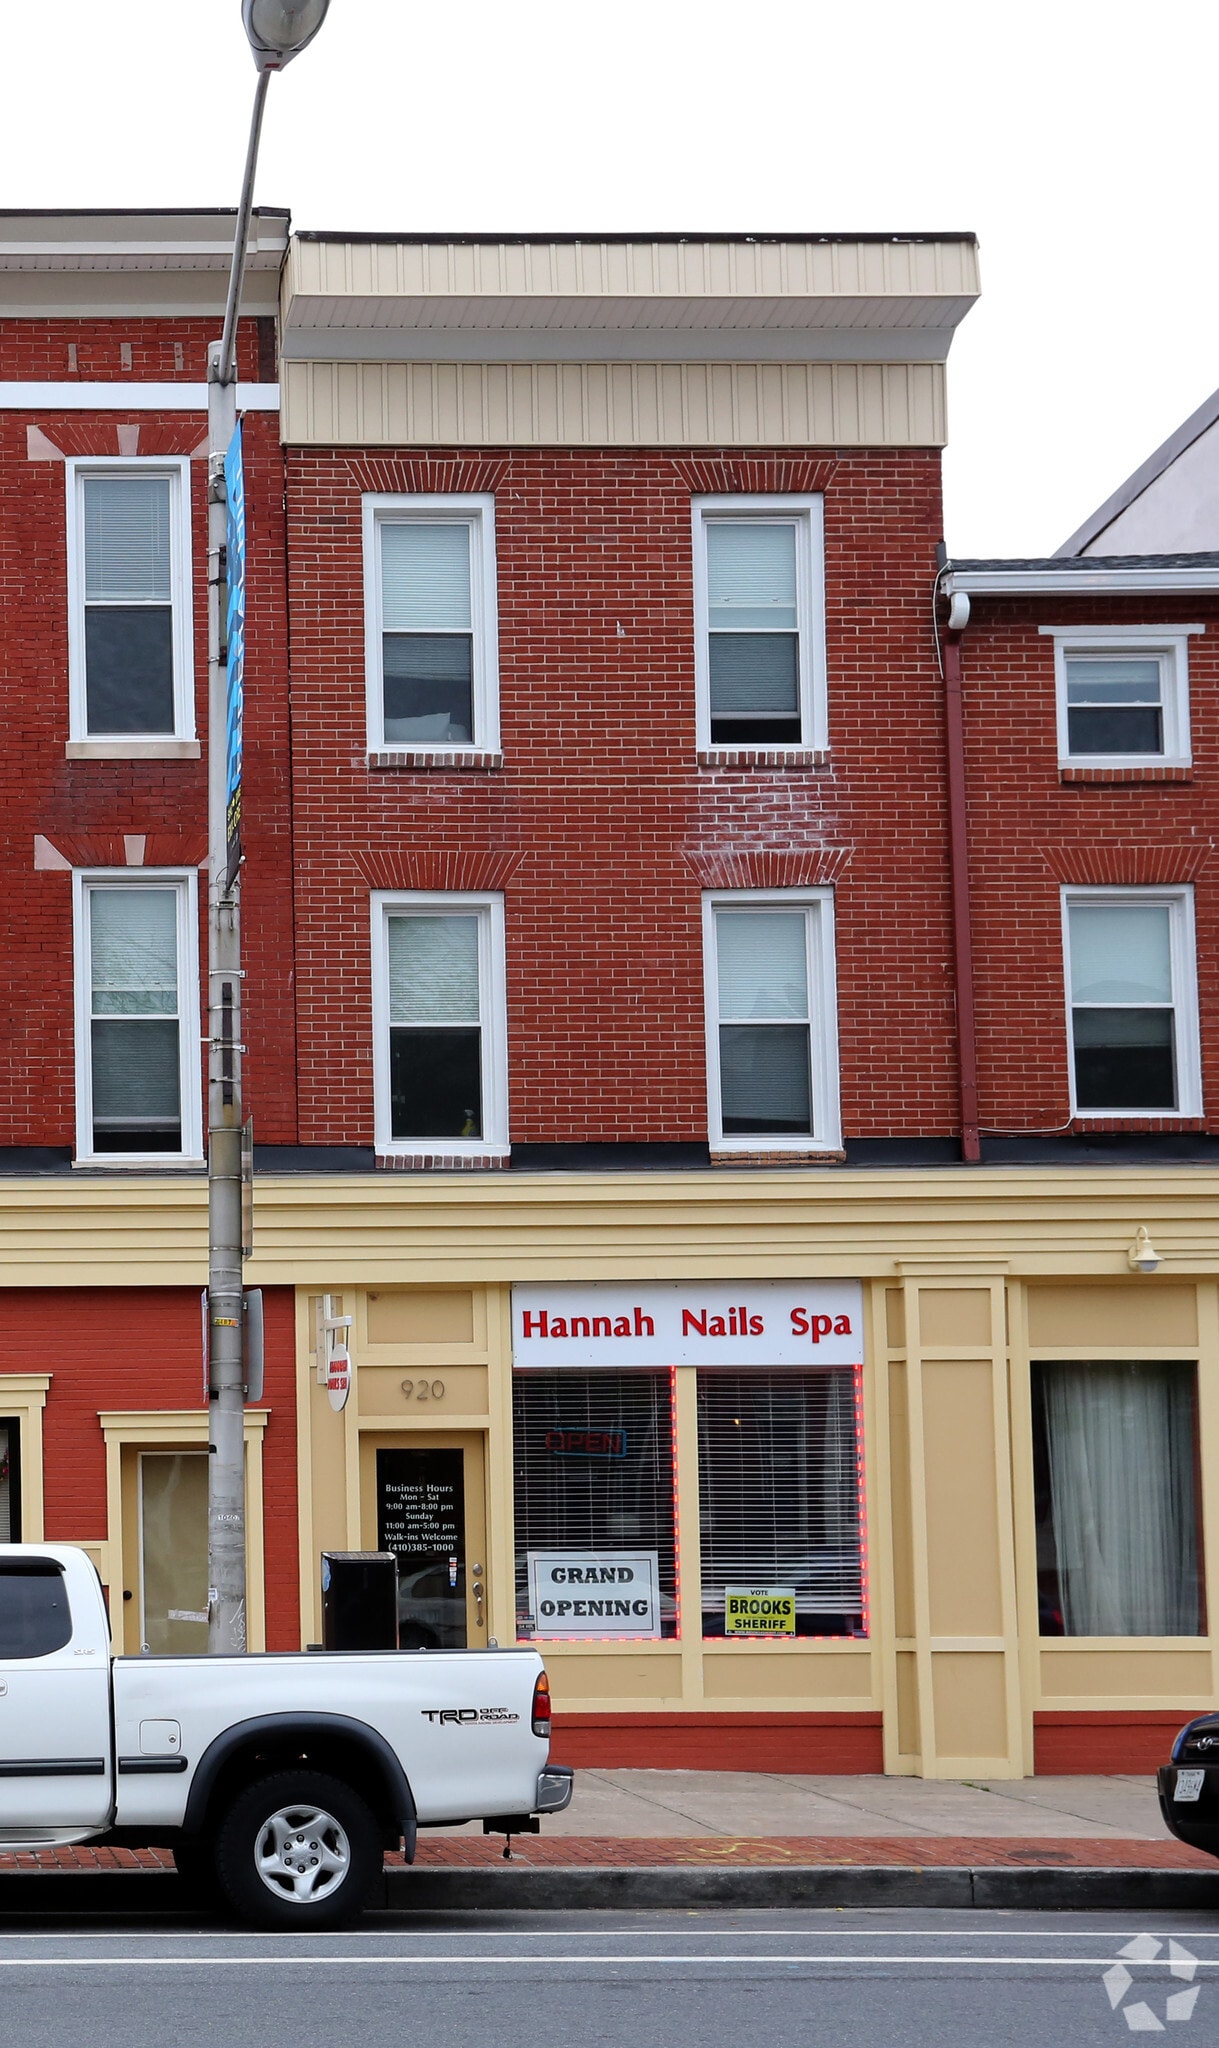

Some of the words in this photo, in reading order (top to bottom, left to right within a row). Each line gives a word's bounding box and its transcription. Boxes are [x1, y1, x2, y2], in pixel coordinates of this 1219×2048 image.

[522, 1307, 655, 1338] Hannah
[682, 1307, 764, 1336] Nails
[790, 1308, 852, 1343] Spa
[400, 1379, 445, 1401] 920
[546, 1432, 622, 1454] OPEN
[385, 1483, 423, 1492] Business
[426, 1484, 454, 1493] Hours
[399, 1493, 418, 1501] Mon
[427, 1493, 439, 1501] Sat
[405, 1512, 434, 1521] Sunday
[385, 1522, 405, 1530] 11:00
[407, 1522, 440, 1530] am-5:00
[442, 1523, 455, 1531] pm
[384, 1533, 419, 1541] Walk-ins
[421, 1533, 458, 1541] Welcome
[388, 1543, 454, 1552] (410)385-1000
[550, 1567, 634, 1584] GRAND
[540, 1599, 648, 1617] OPENING
[730, 1599, 791, 1615] BROOKS
[735, 1619, 786, 1629] SHERIFF
[421, 1709, 479, 1726] TRD
[480, 1713, 519, 1721] ROAD
